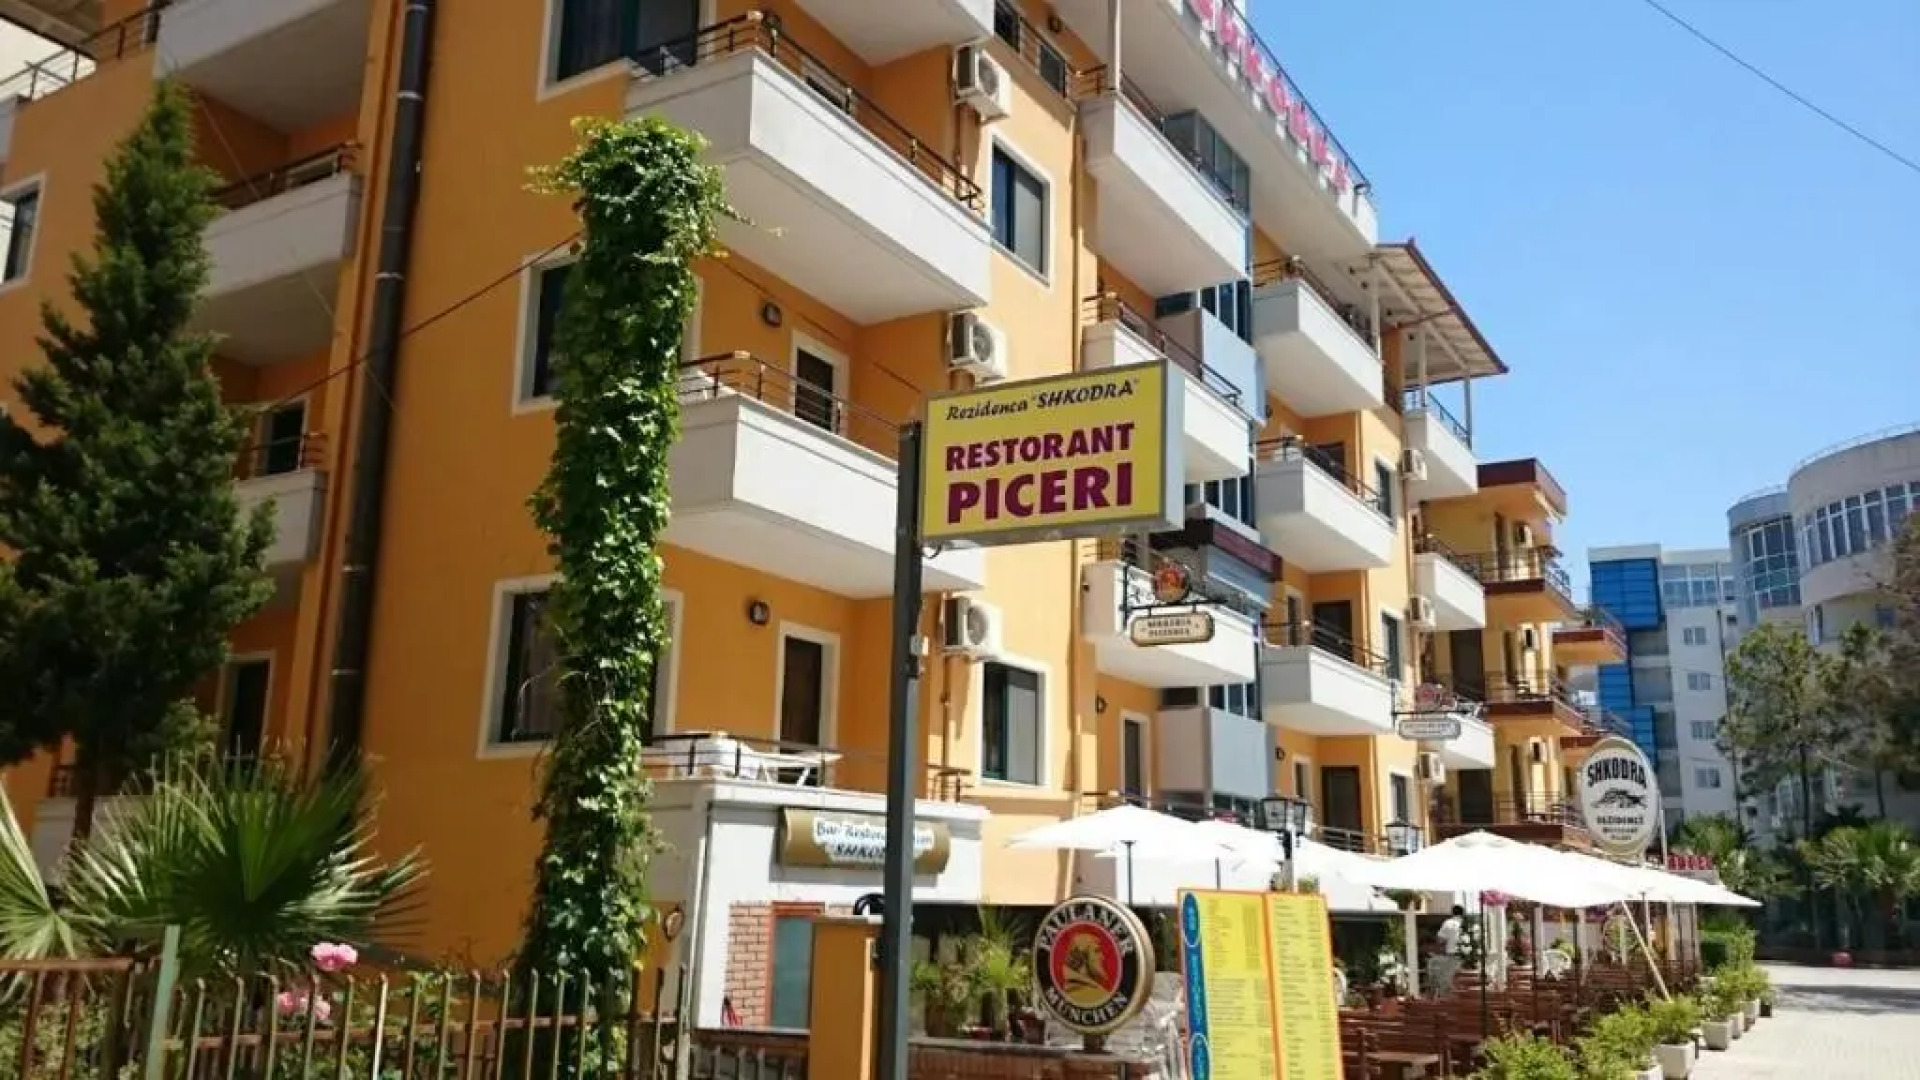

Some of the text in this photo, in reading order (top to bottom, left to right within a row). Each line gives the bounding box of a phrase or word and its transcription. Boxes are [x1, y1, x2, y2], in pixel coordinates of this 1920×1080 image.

[945, 399, 1029, 421] Rezidenca
[945, 421, 1135, 472] RESTORANT
[947, 461, 1133, 525] PICERI
[1587, 756, 1647, 790] SHKODRA
[1039, 903, 1134, 958] PAULANER
